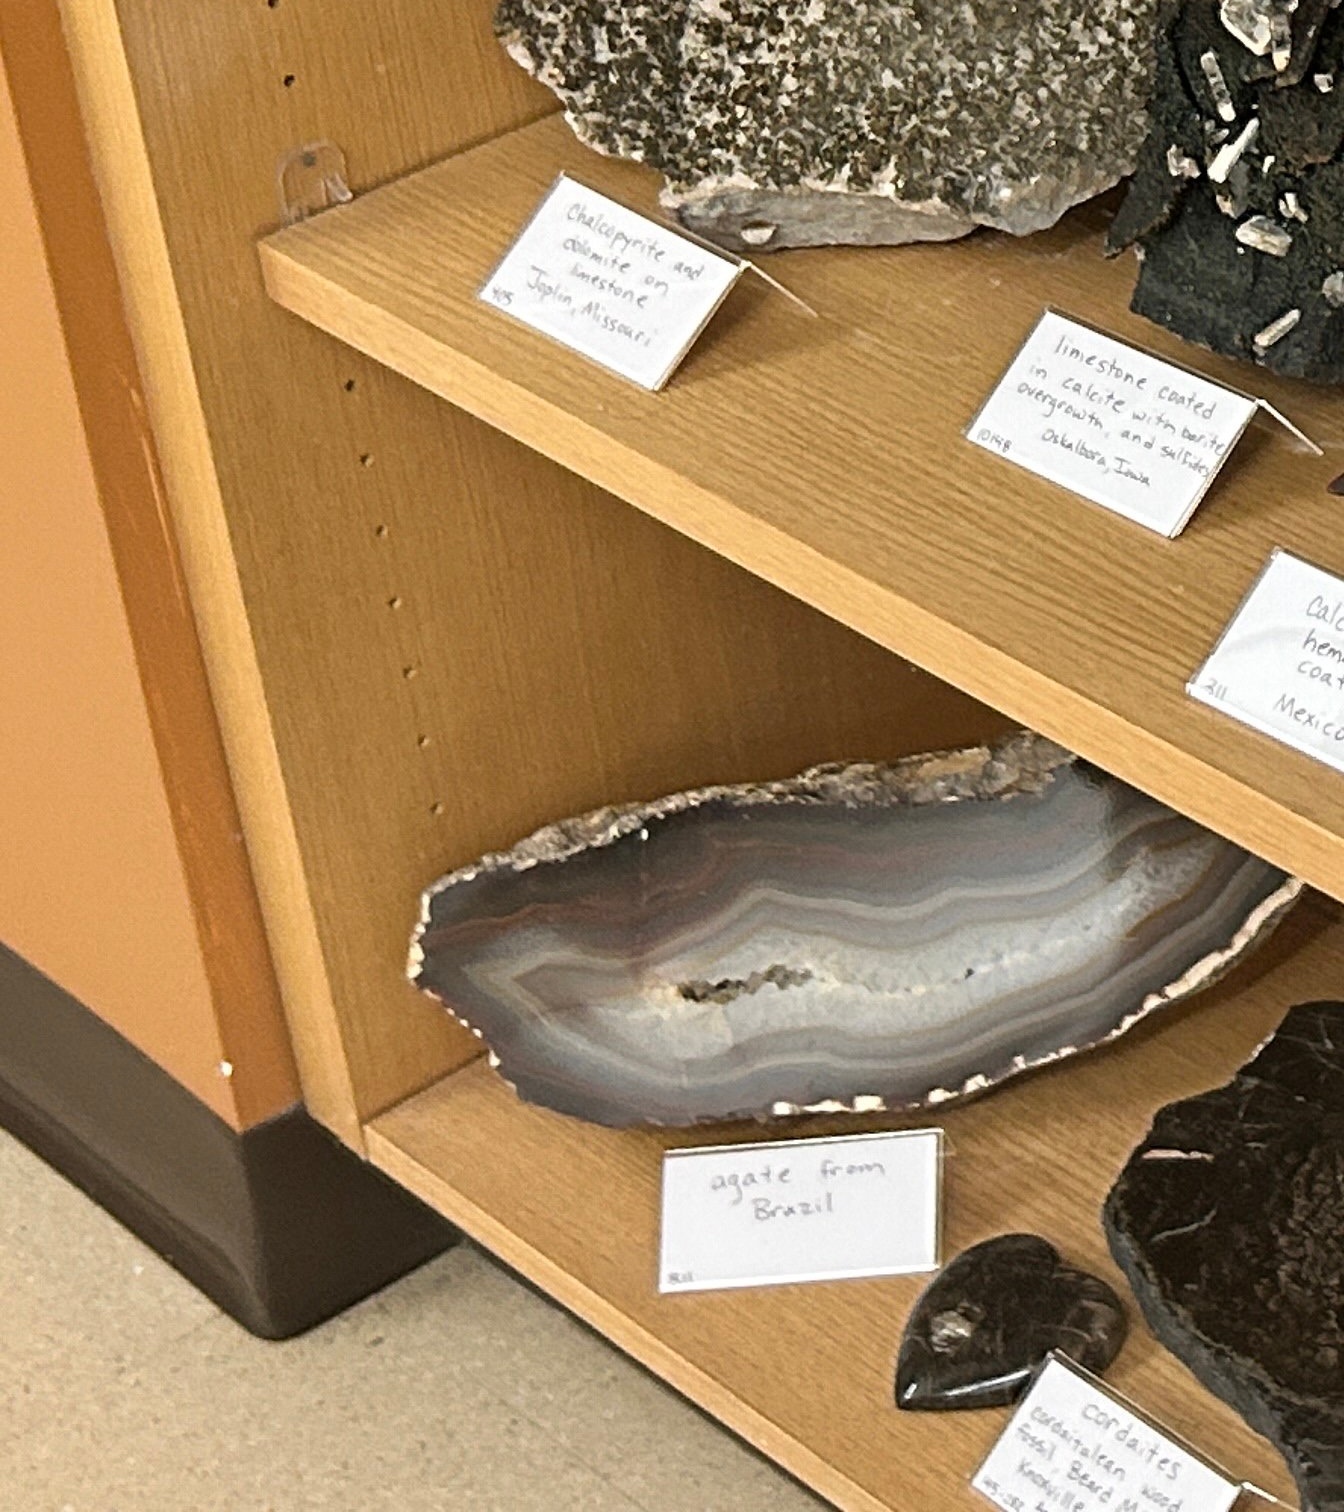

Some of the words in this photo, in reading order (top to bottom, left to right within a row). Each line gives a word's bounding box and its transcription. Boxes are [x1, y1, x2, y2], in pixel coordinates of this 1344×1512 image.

[567, 203, 665, 262] Chalcopyrite
[673, 261, 705, 281] and
[644, 273, 668, 295] on
[580, 300, 658, 347] Missouri
[1029, 360, 1048, 379] in
[1062, 376, 1125, 414] calcite
[1132, 408, 1177, 435] with
[1054, 335, 1147, 390] limestone
[1158, 384, 1216, 420] coated
[1121, 429, 1156, 450] and
[1112, 456, 1151, 488] Iowa
[711, 1165, 791, 1206] agate
[821, 1159, 885, 1178] from
[753, 1192, 833, 1221] Brazil
